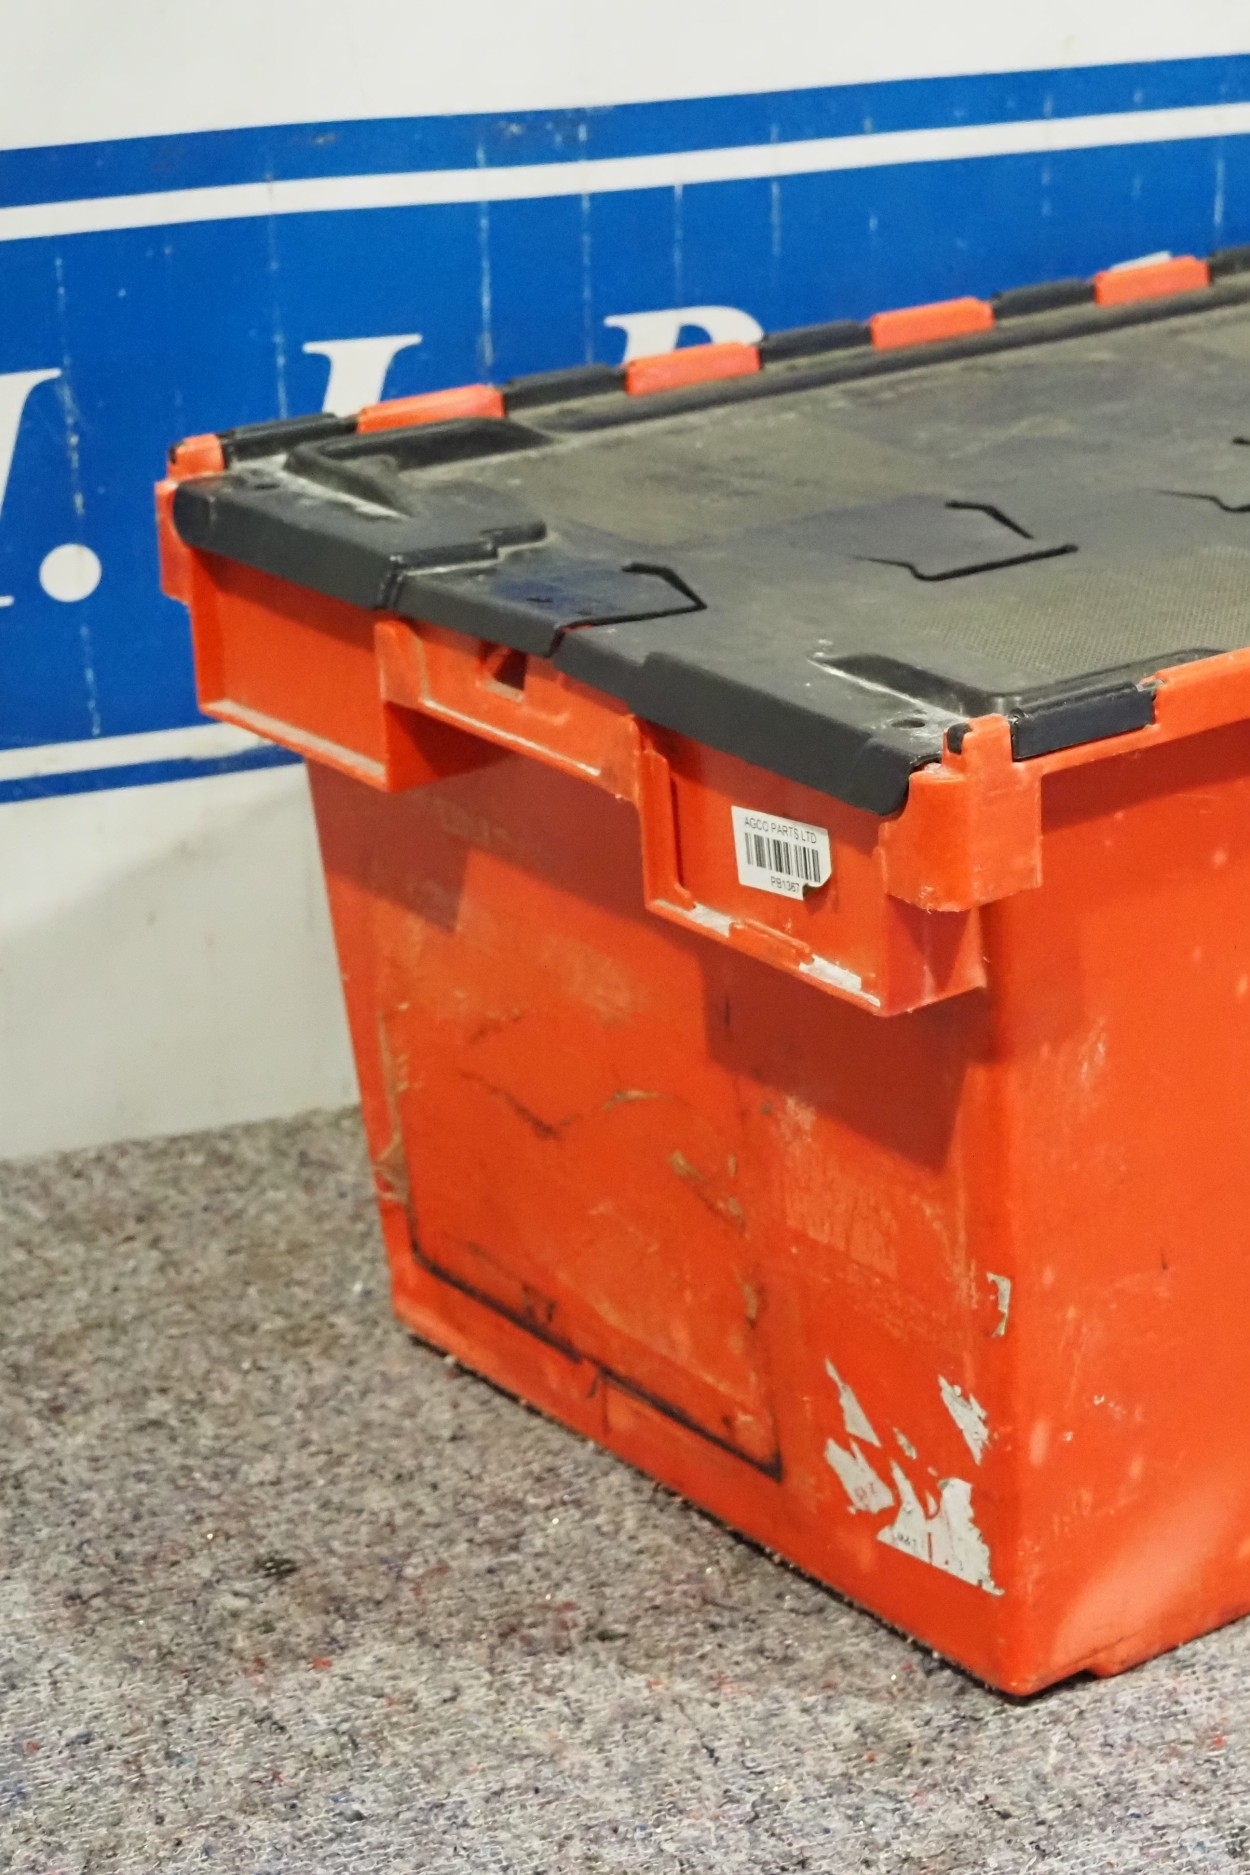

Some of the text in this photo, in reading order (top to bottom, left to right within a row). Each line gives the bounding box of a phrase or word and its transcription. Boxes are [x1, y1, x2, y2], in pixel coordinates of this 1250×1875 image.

[744, 816, 817, 844] AGCO PARTS LTD
